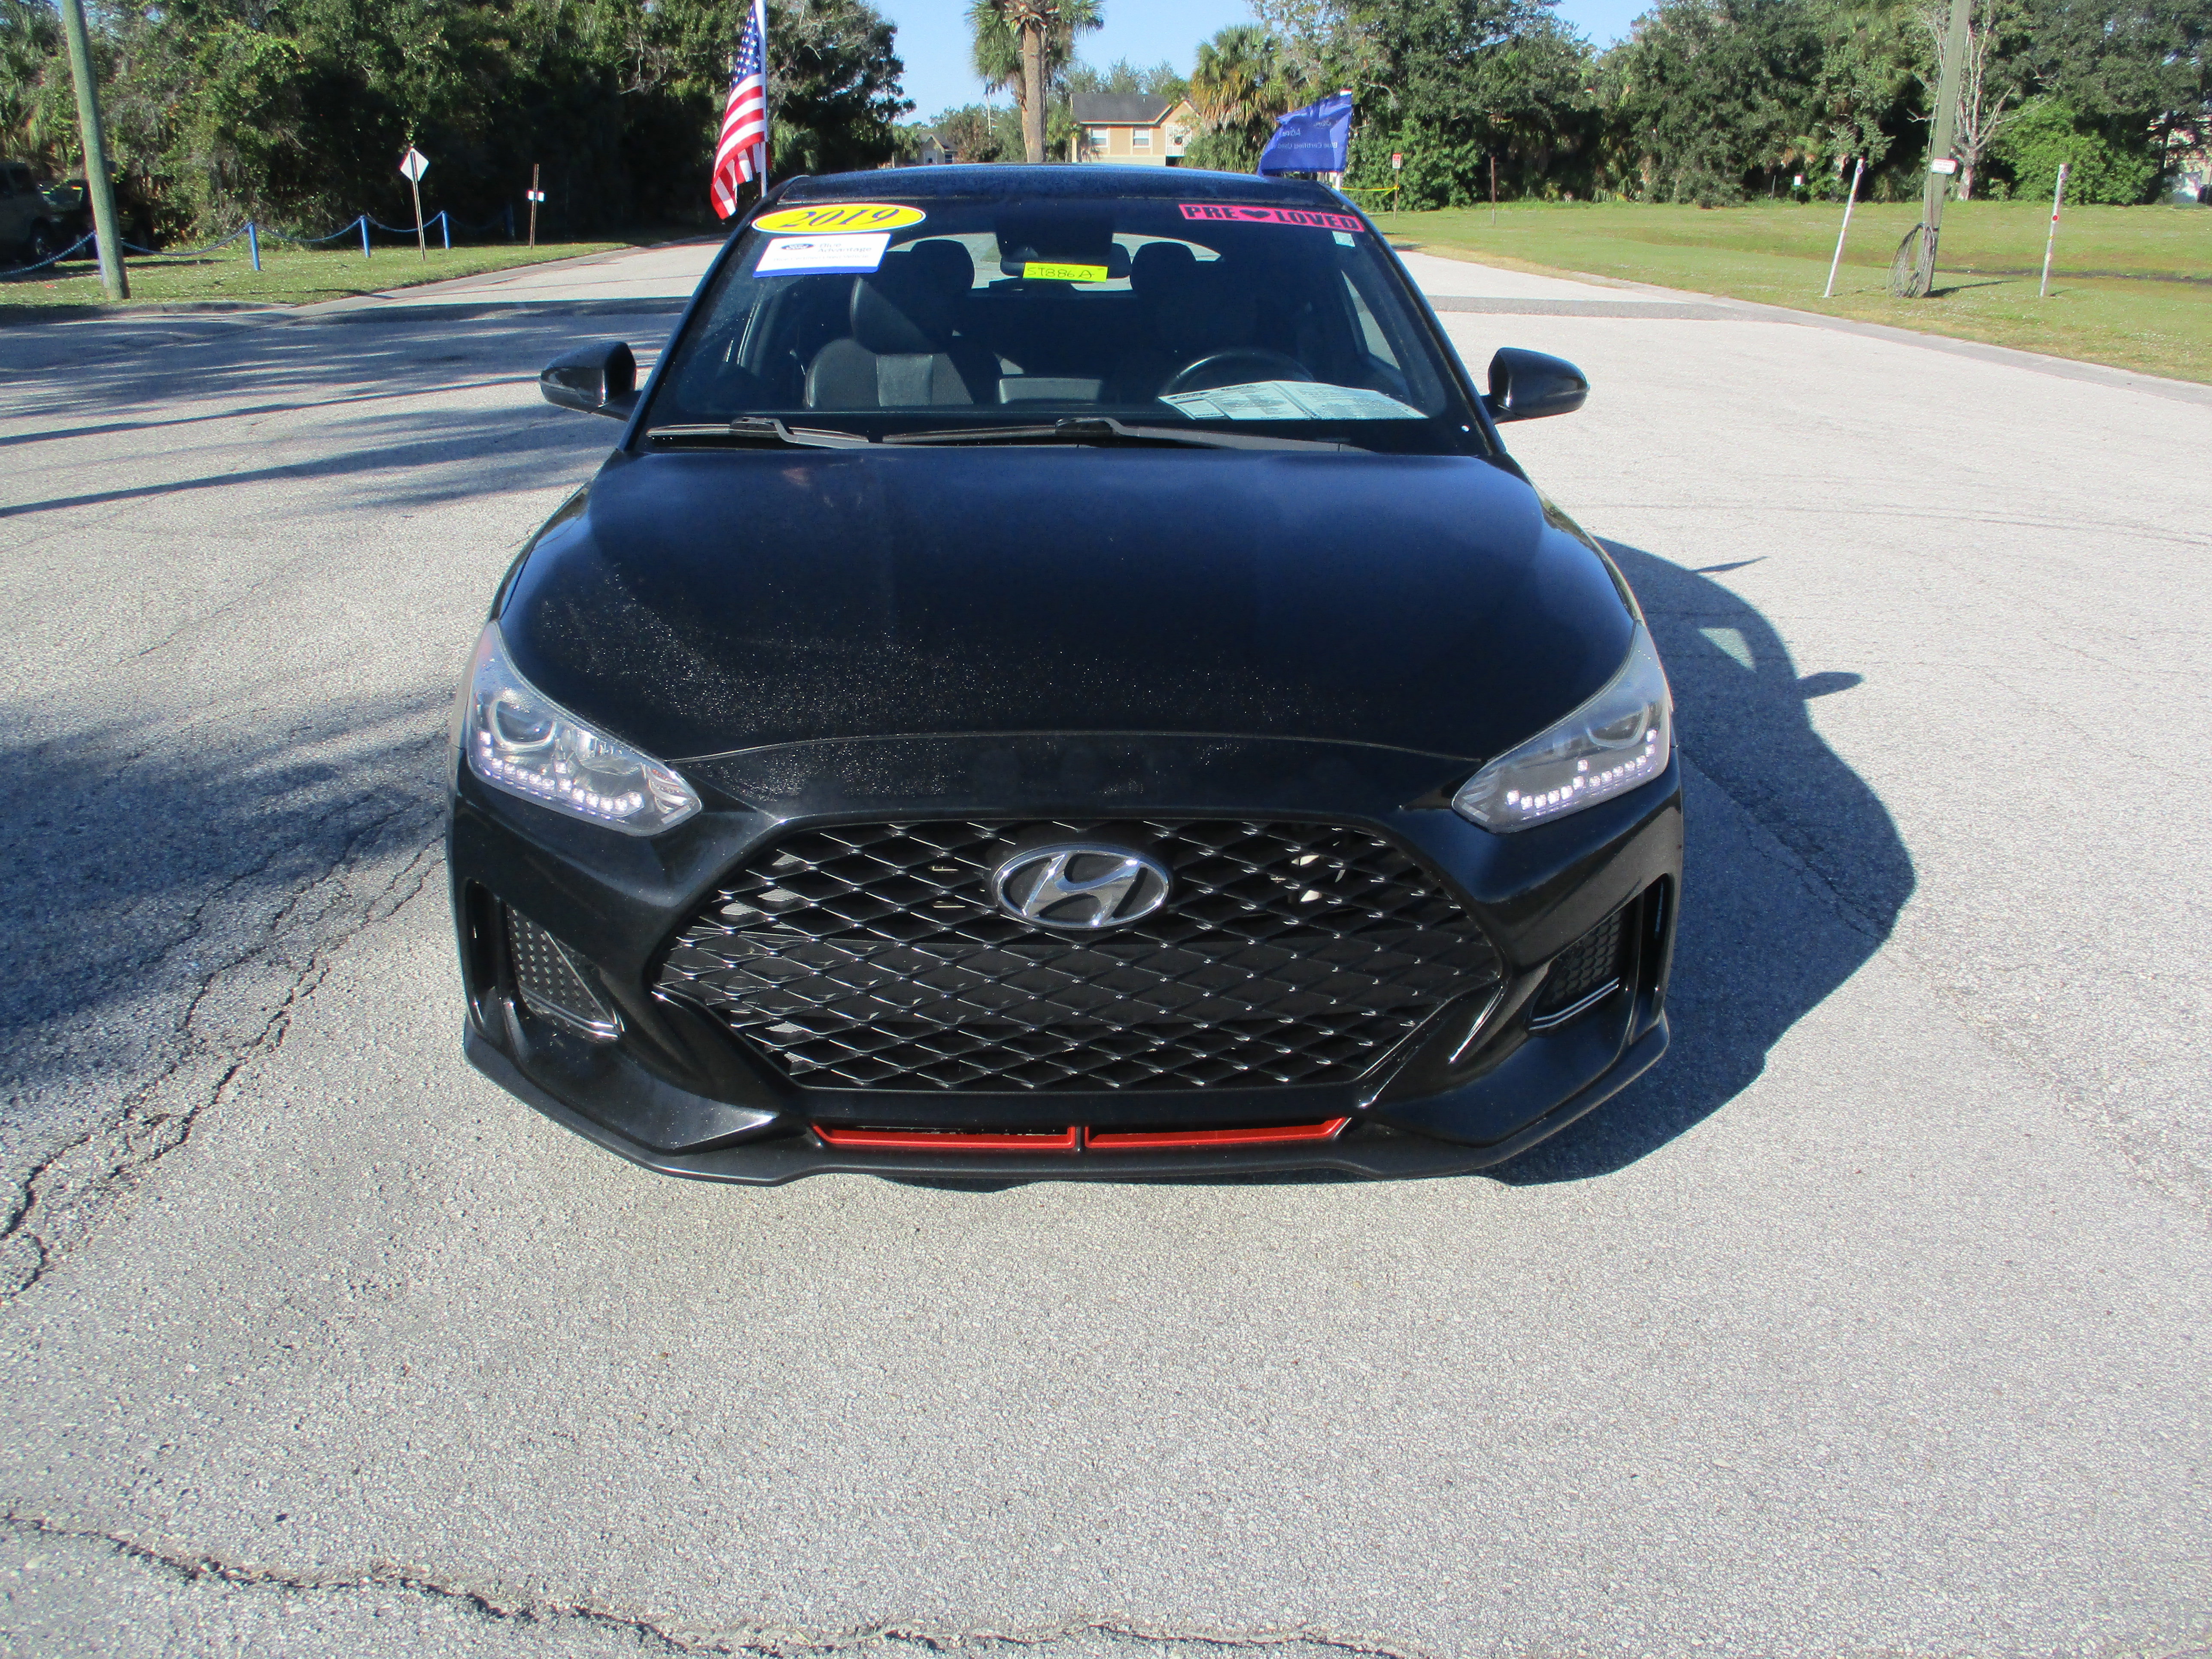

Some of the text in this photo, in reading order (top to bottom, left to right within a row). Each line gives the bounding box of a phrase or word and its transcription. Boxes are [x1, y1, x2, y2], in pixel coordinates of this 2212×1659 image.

[776, 209, 899, 228] 2019
[1185, 206, 1360, 230] PRE LOVED
